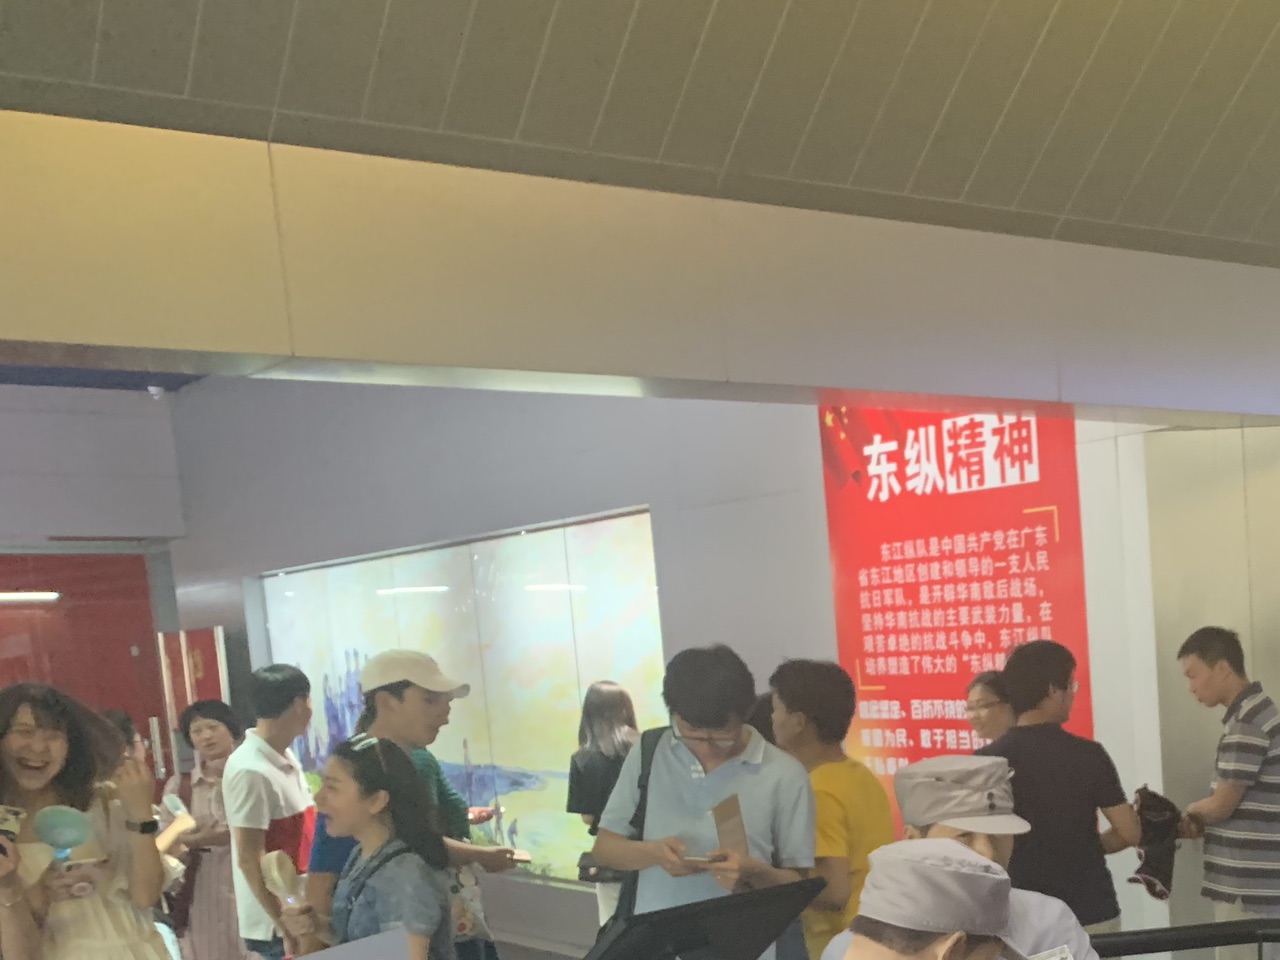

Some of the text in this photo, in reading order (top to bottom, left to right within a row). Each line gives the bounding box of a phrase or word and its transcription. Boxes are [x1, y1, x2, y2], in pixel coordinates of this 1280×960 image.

[863, 412, 1040, 503] 东纵精神
[880, 526, 1048, 562] 东江纵队是中国共产党在广东
[858, 550, 1050, 587] 省东江地区创建和领导的一支人民
